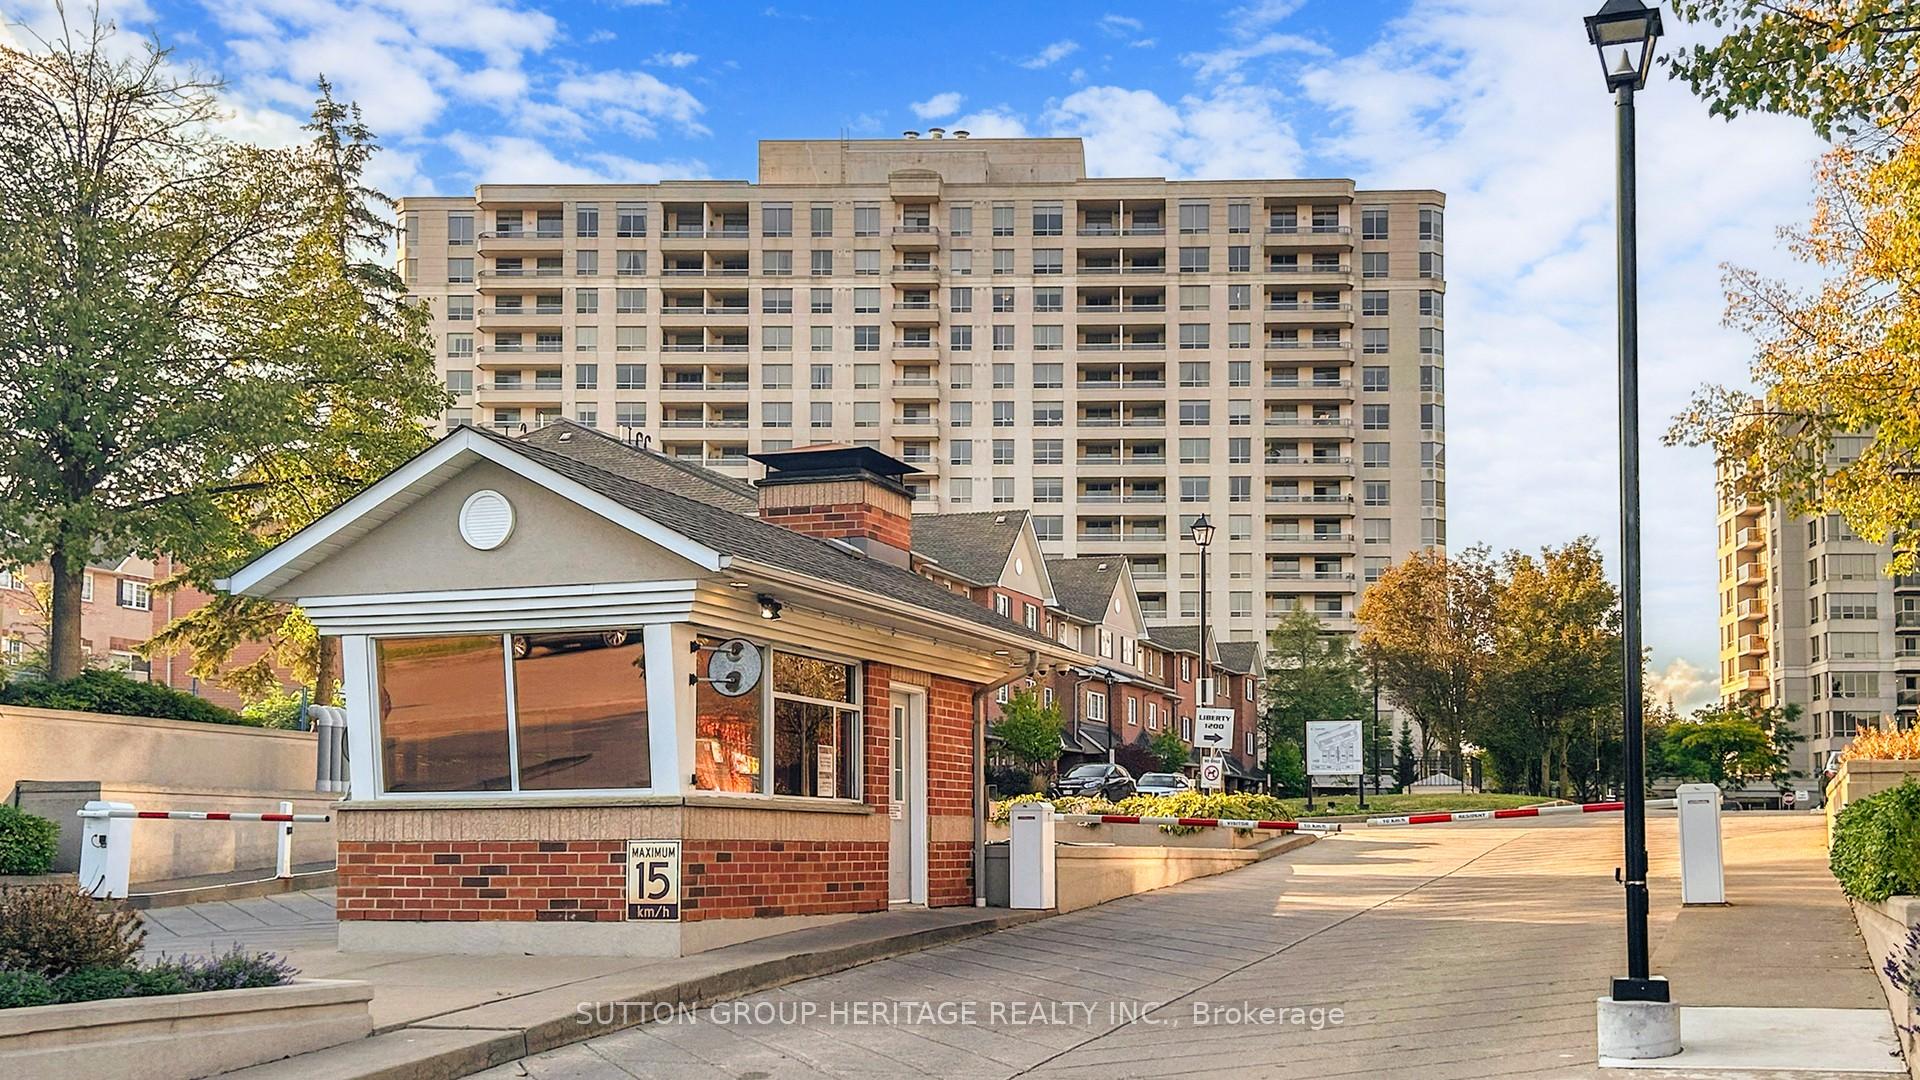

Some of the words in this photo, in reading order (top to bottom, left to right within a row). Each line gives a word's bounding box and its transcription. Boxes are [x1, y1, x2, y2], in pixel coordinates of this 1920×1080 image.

[632, 847, 675, 858] MAXIMUM
[636, 862, 670, 900] 15
[637, 905, 670, 918] km/h
